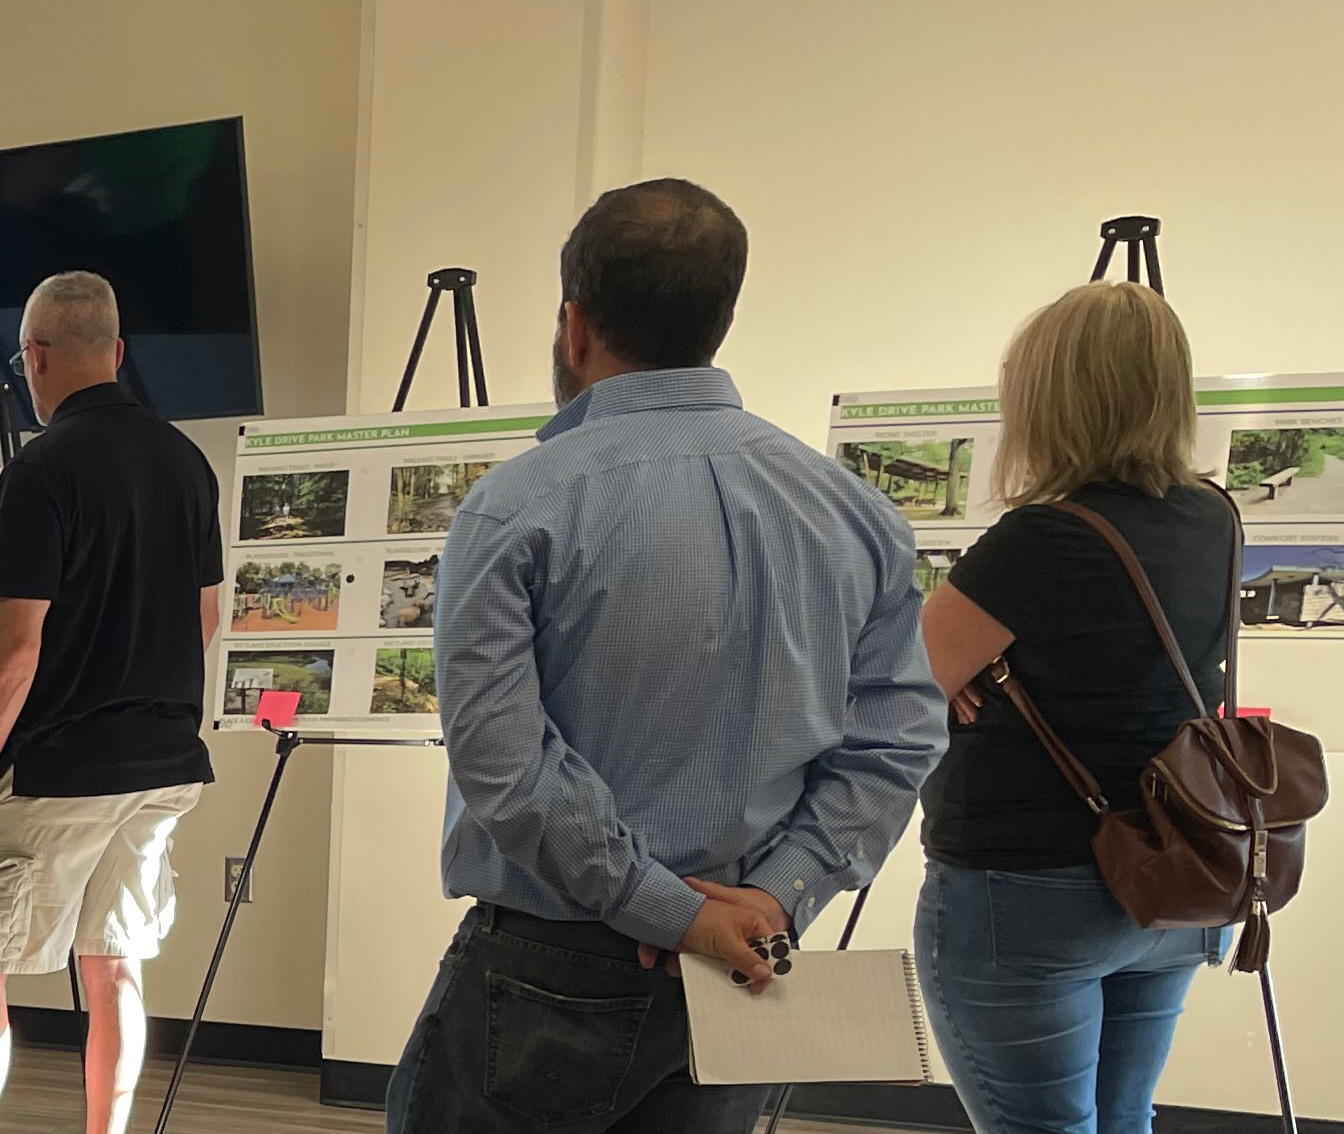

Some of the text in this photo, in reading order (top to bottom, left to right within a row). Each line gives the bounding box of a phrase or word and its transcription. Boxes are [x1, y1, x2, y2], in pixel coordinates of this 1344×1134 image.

[841, 400, 1000, 417] KYLE DRIVE PARK MASTE
[246, 427, 410, 447] KYLE DRIVE PARK MASTER PLAN
